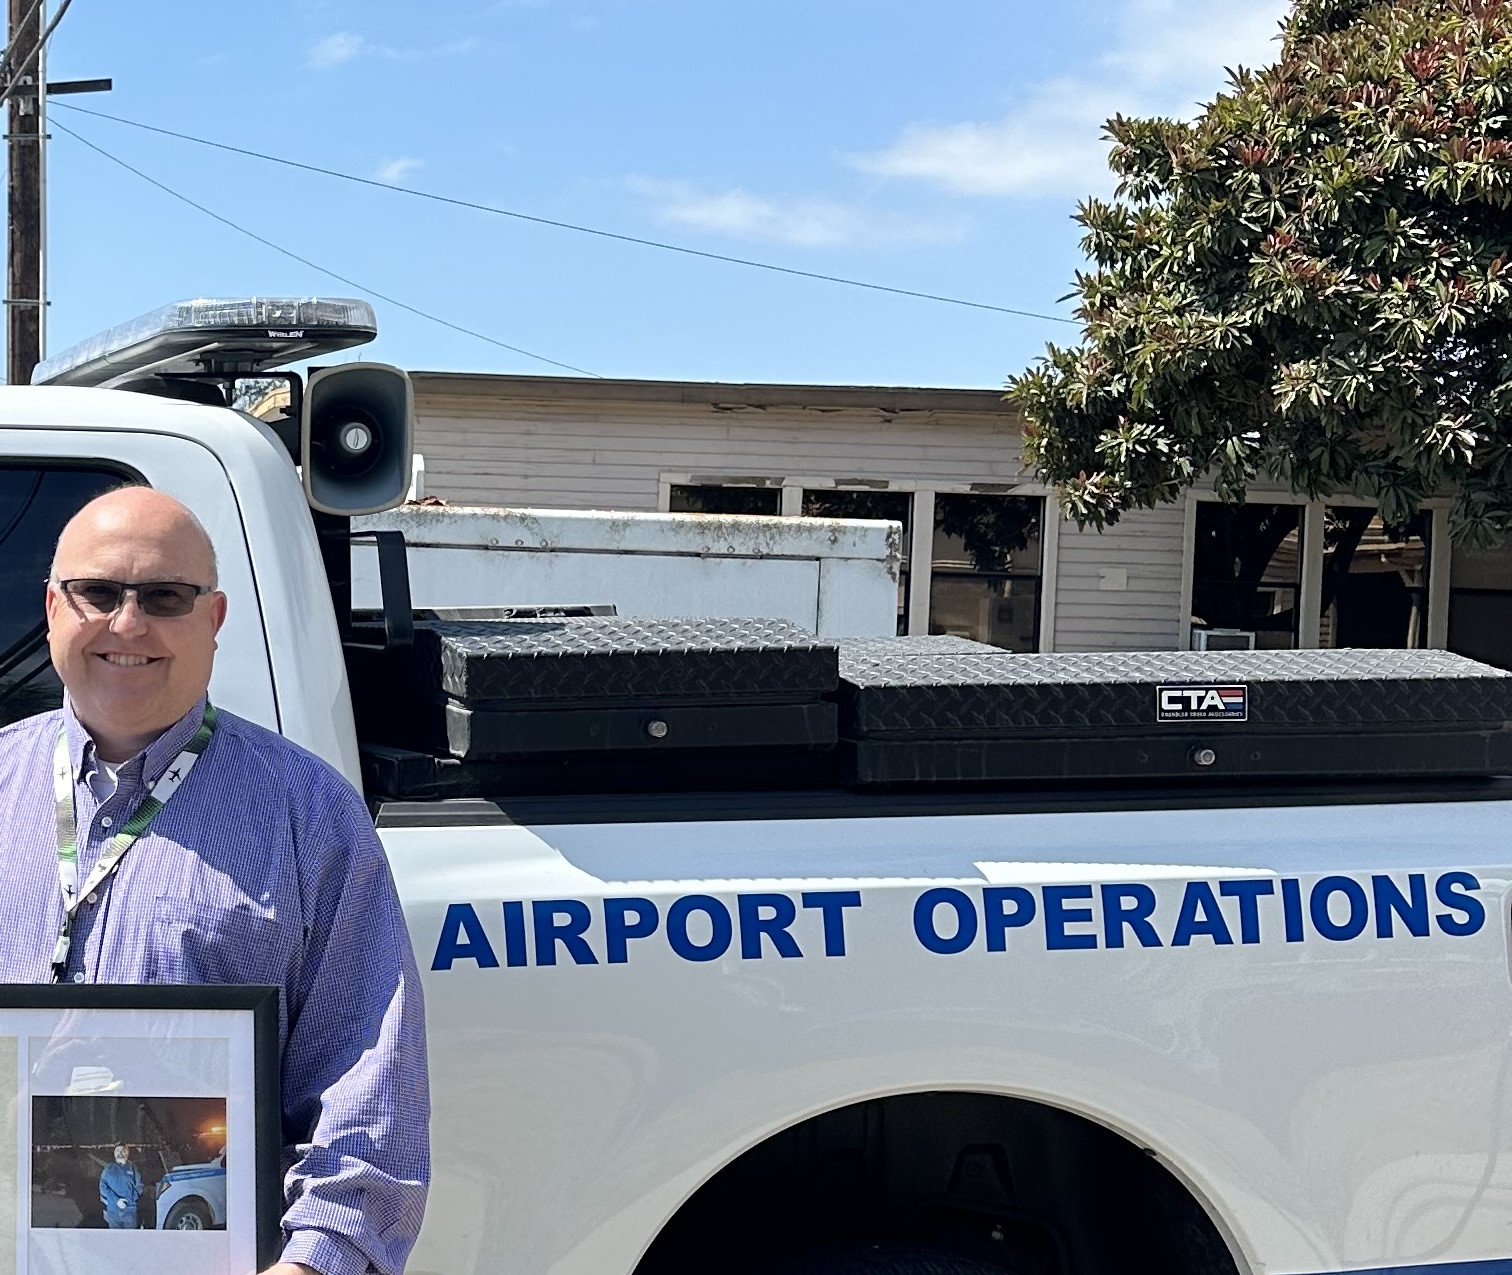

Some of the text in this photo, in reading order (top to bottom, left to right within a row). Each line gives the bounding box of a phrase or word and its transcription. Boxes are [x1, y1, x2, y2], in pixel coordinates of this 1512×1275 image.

[1161, 690, 1225, 710] CTA
[432, 871, 1485, 971] AIRPORT OPERATIONS
